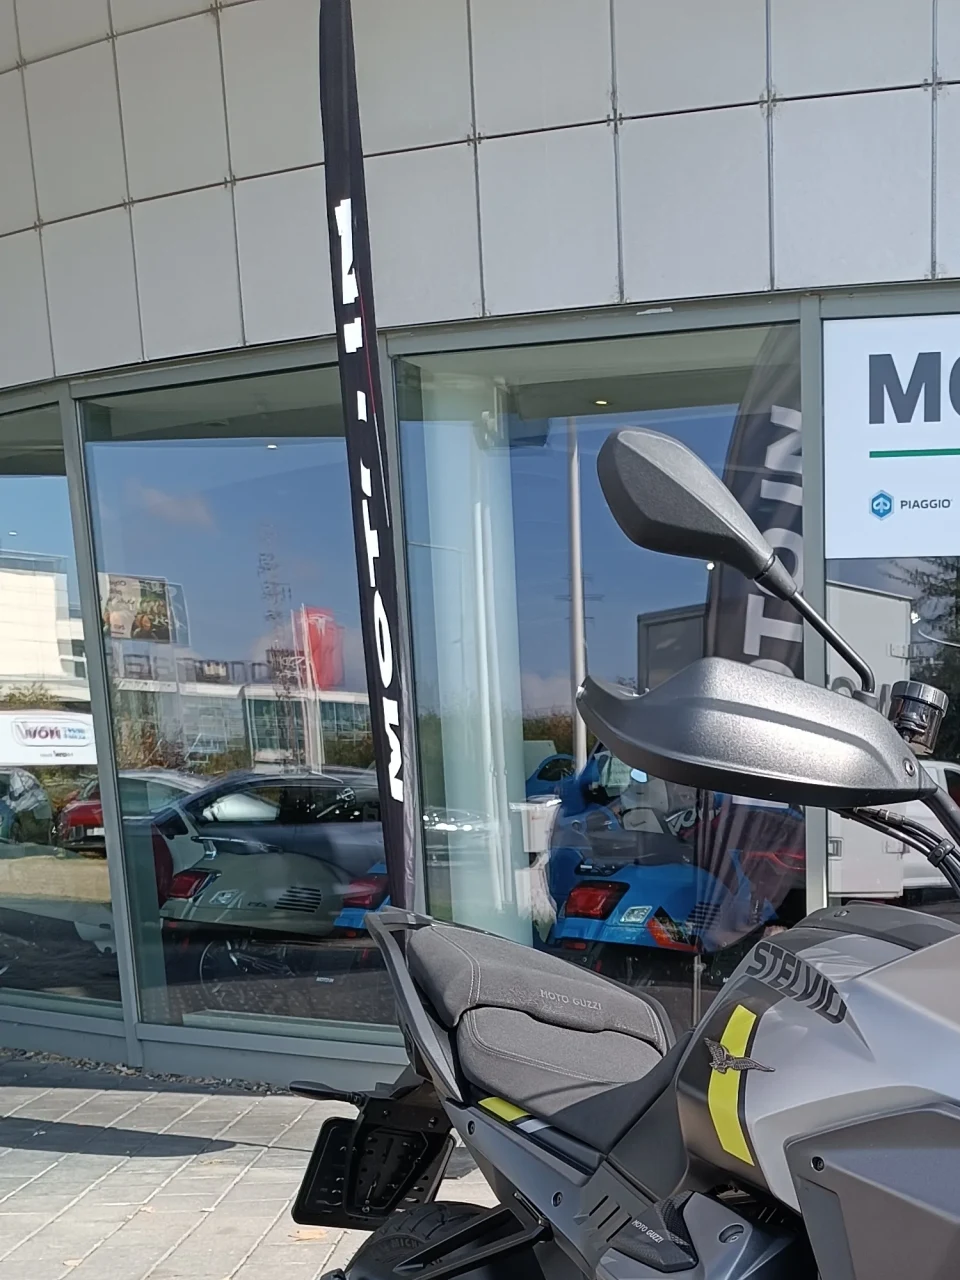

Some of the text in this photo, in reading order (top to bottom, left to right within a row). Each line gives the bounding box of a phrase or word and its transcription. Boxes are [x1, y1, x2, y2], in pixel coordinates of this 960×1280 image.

[900, 498, 952, 510] PIAGGIO
[744, 941, 848, 1025] STELVIO
[540, 988, 602, 1011] MOTO GUZZI
[631, 1219, 665, 1244] MOTO GUZZI
